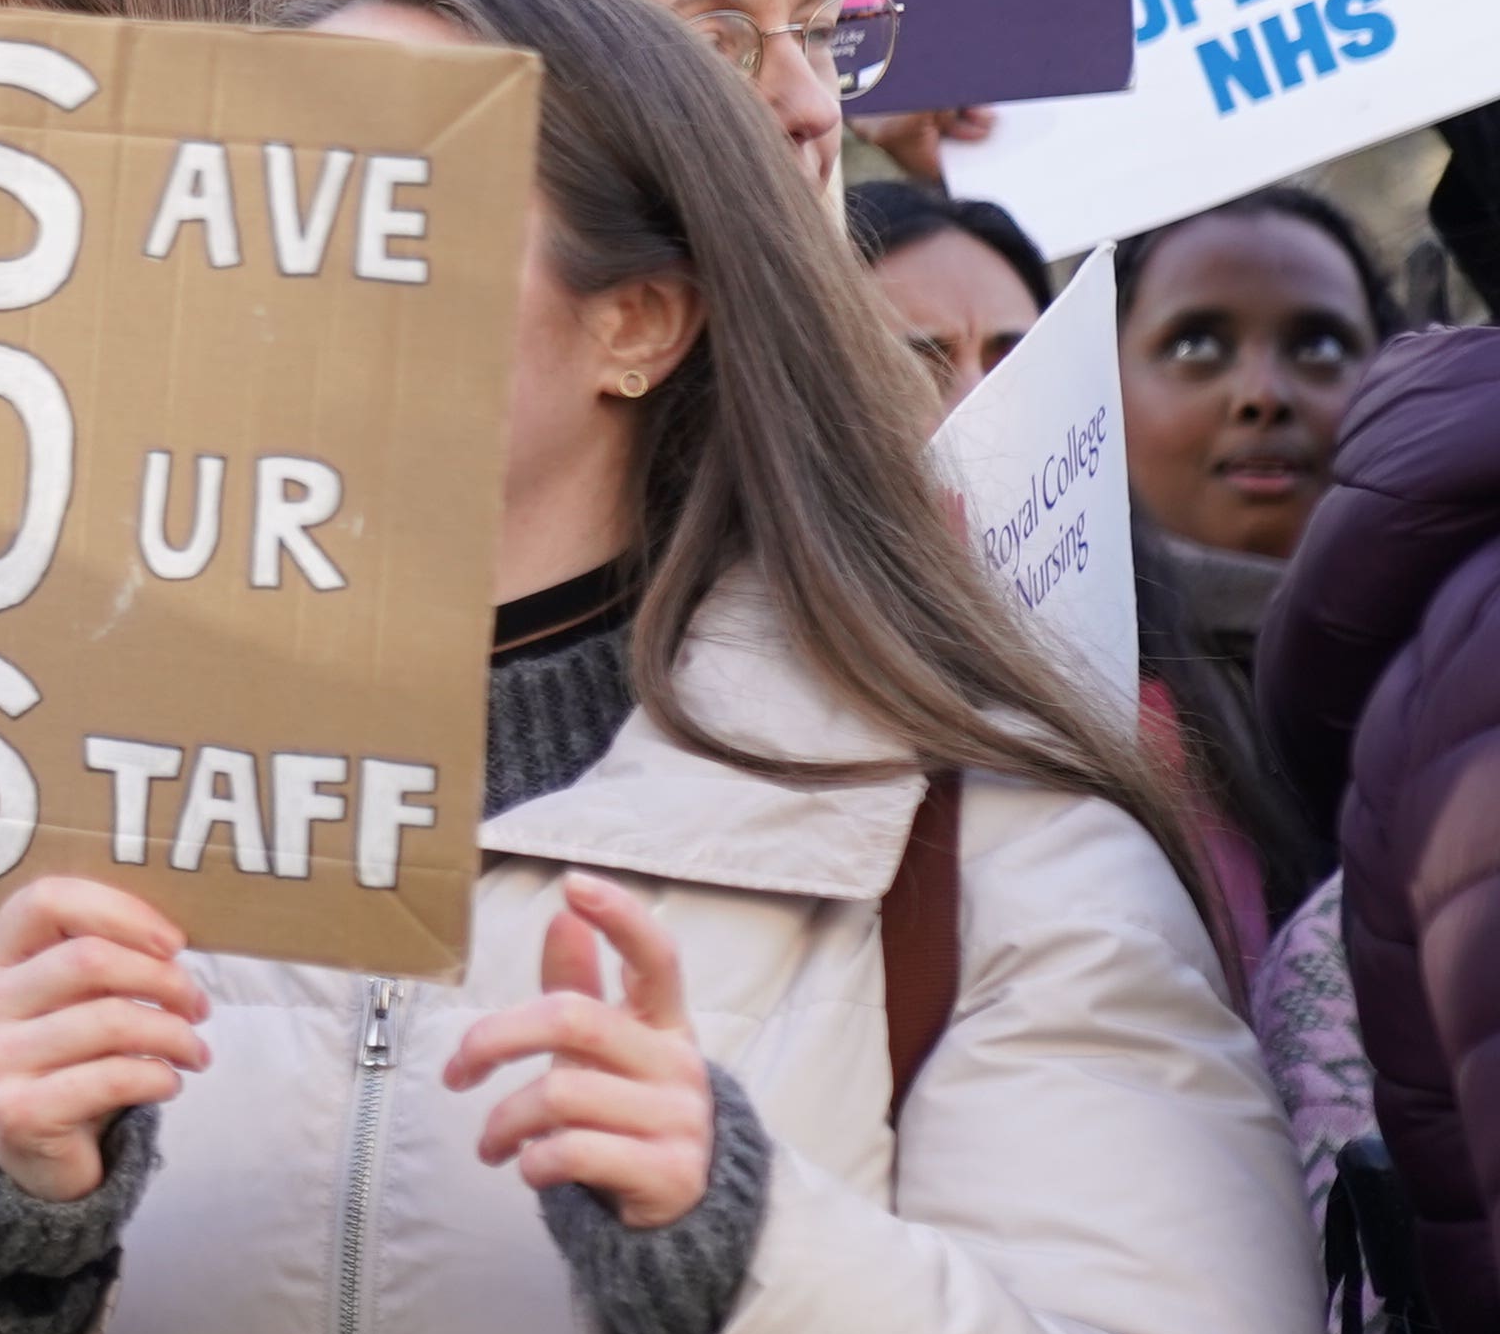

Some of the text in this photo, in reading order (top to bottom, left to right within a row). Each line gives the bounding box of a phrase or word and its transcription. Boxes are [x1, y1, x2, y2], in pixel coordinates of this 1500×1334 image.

[982, 405, 1107, 576] Royal College
[1016, 509, 1089, 611] Nursing
